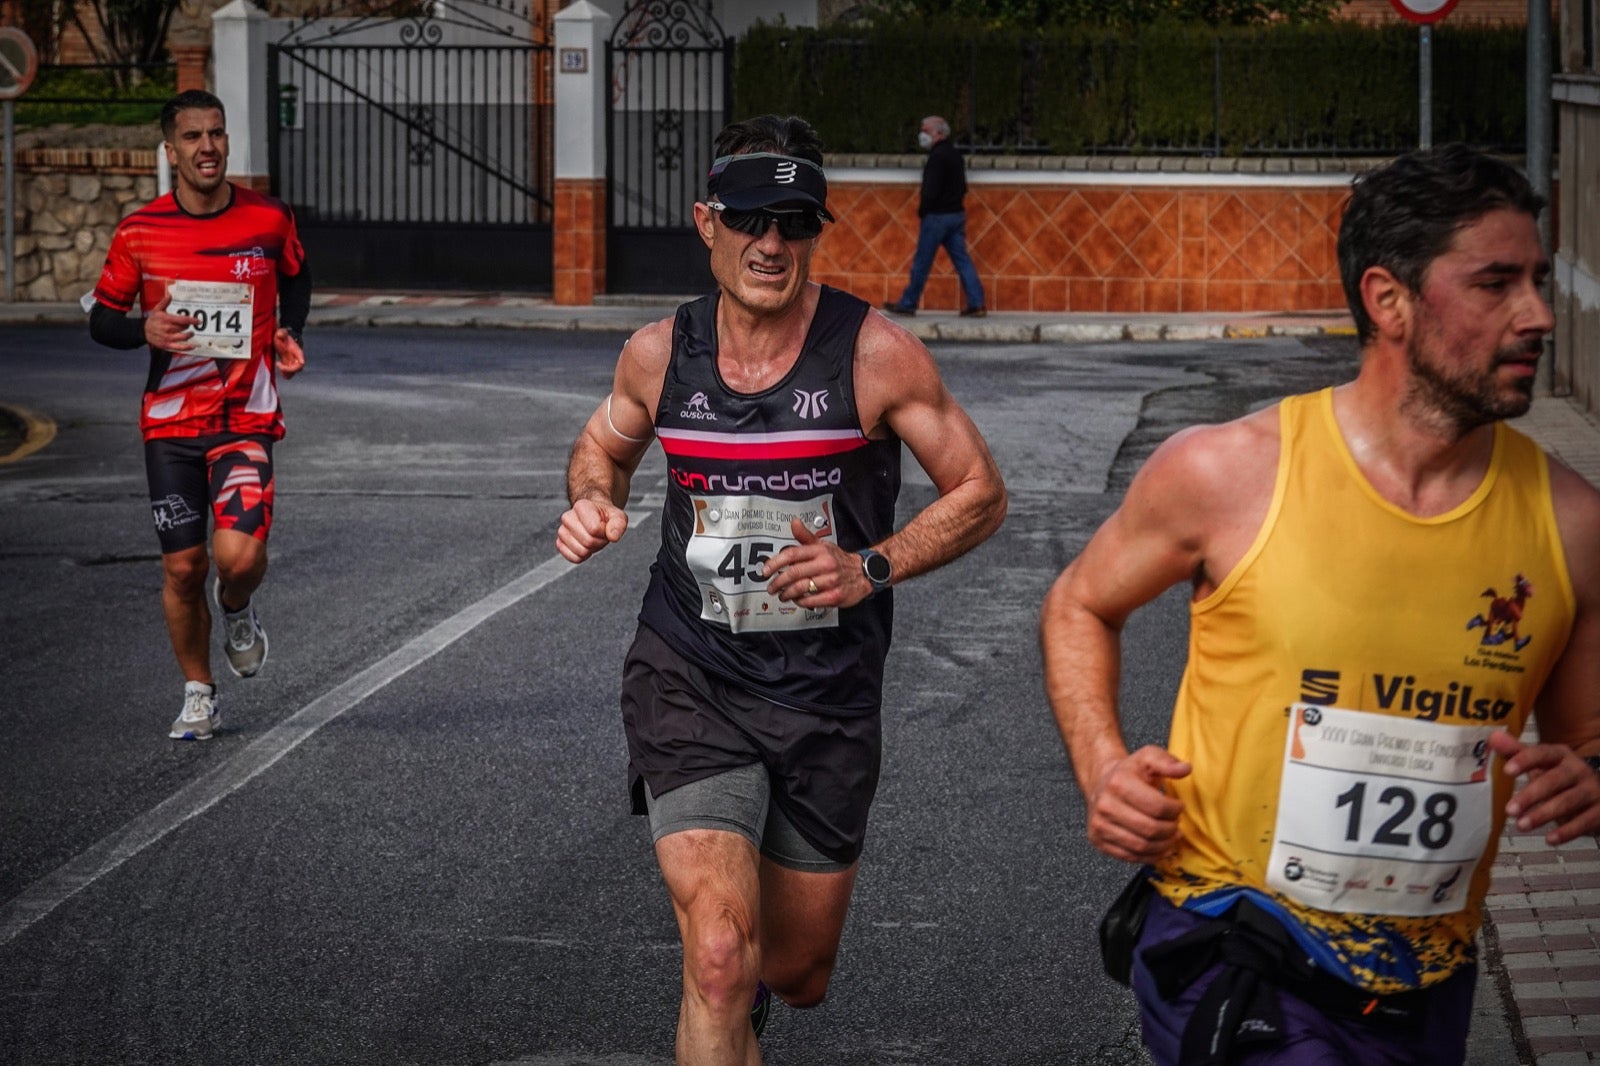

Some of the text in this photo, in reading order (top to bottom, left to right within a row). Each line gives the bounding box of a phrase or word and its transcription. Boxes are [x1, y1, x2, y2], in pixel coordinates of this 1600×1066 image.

[680, 409, 719, 421] austral
[717, 542, 799, 586] 45
[1334, 781, 1458, 850] 128
